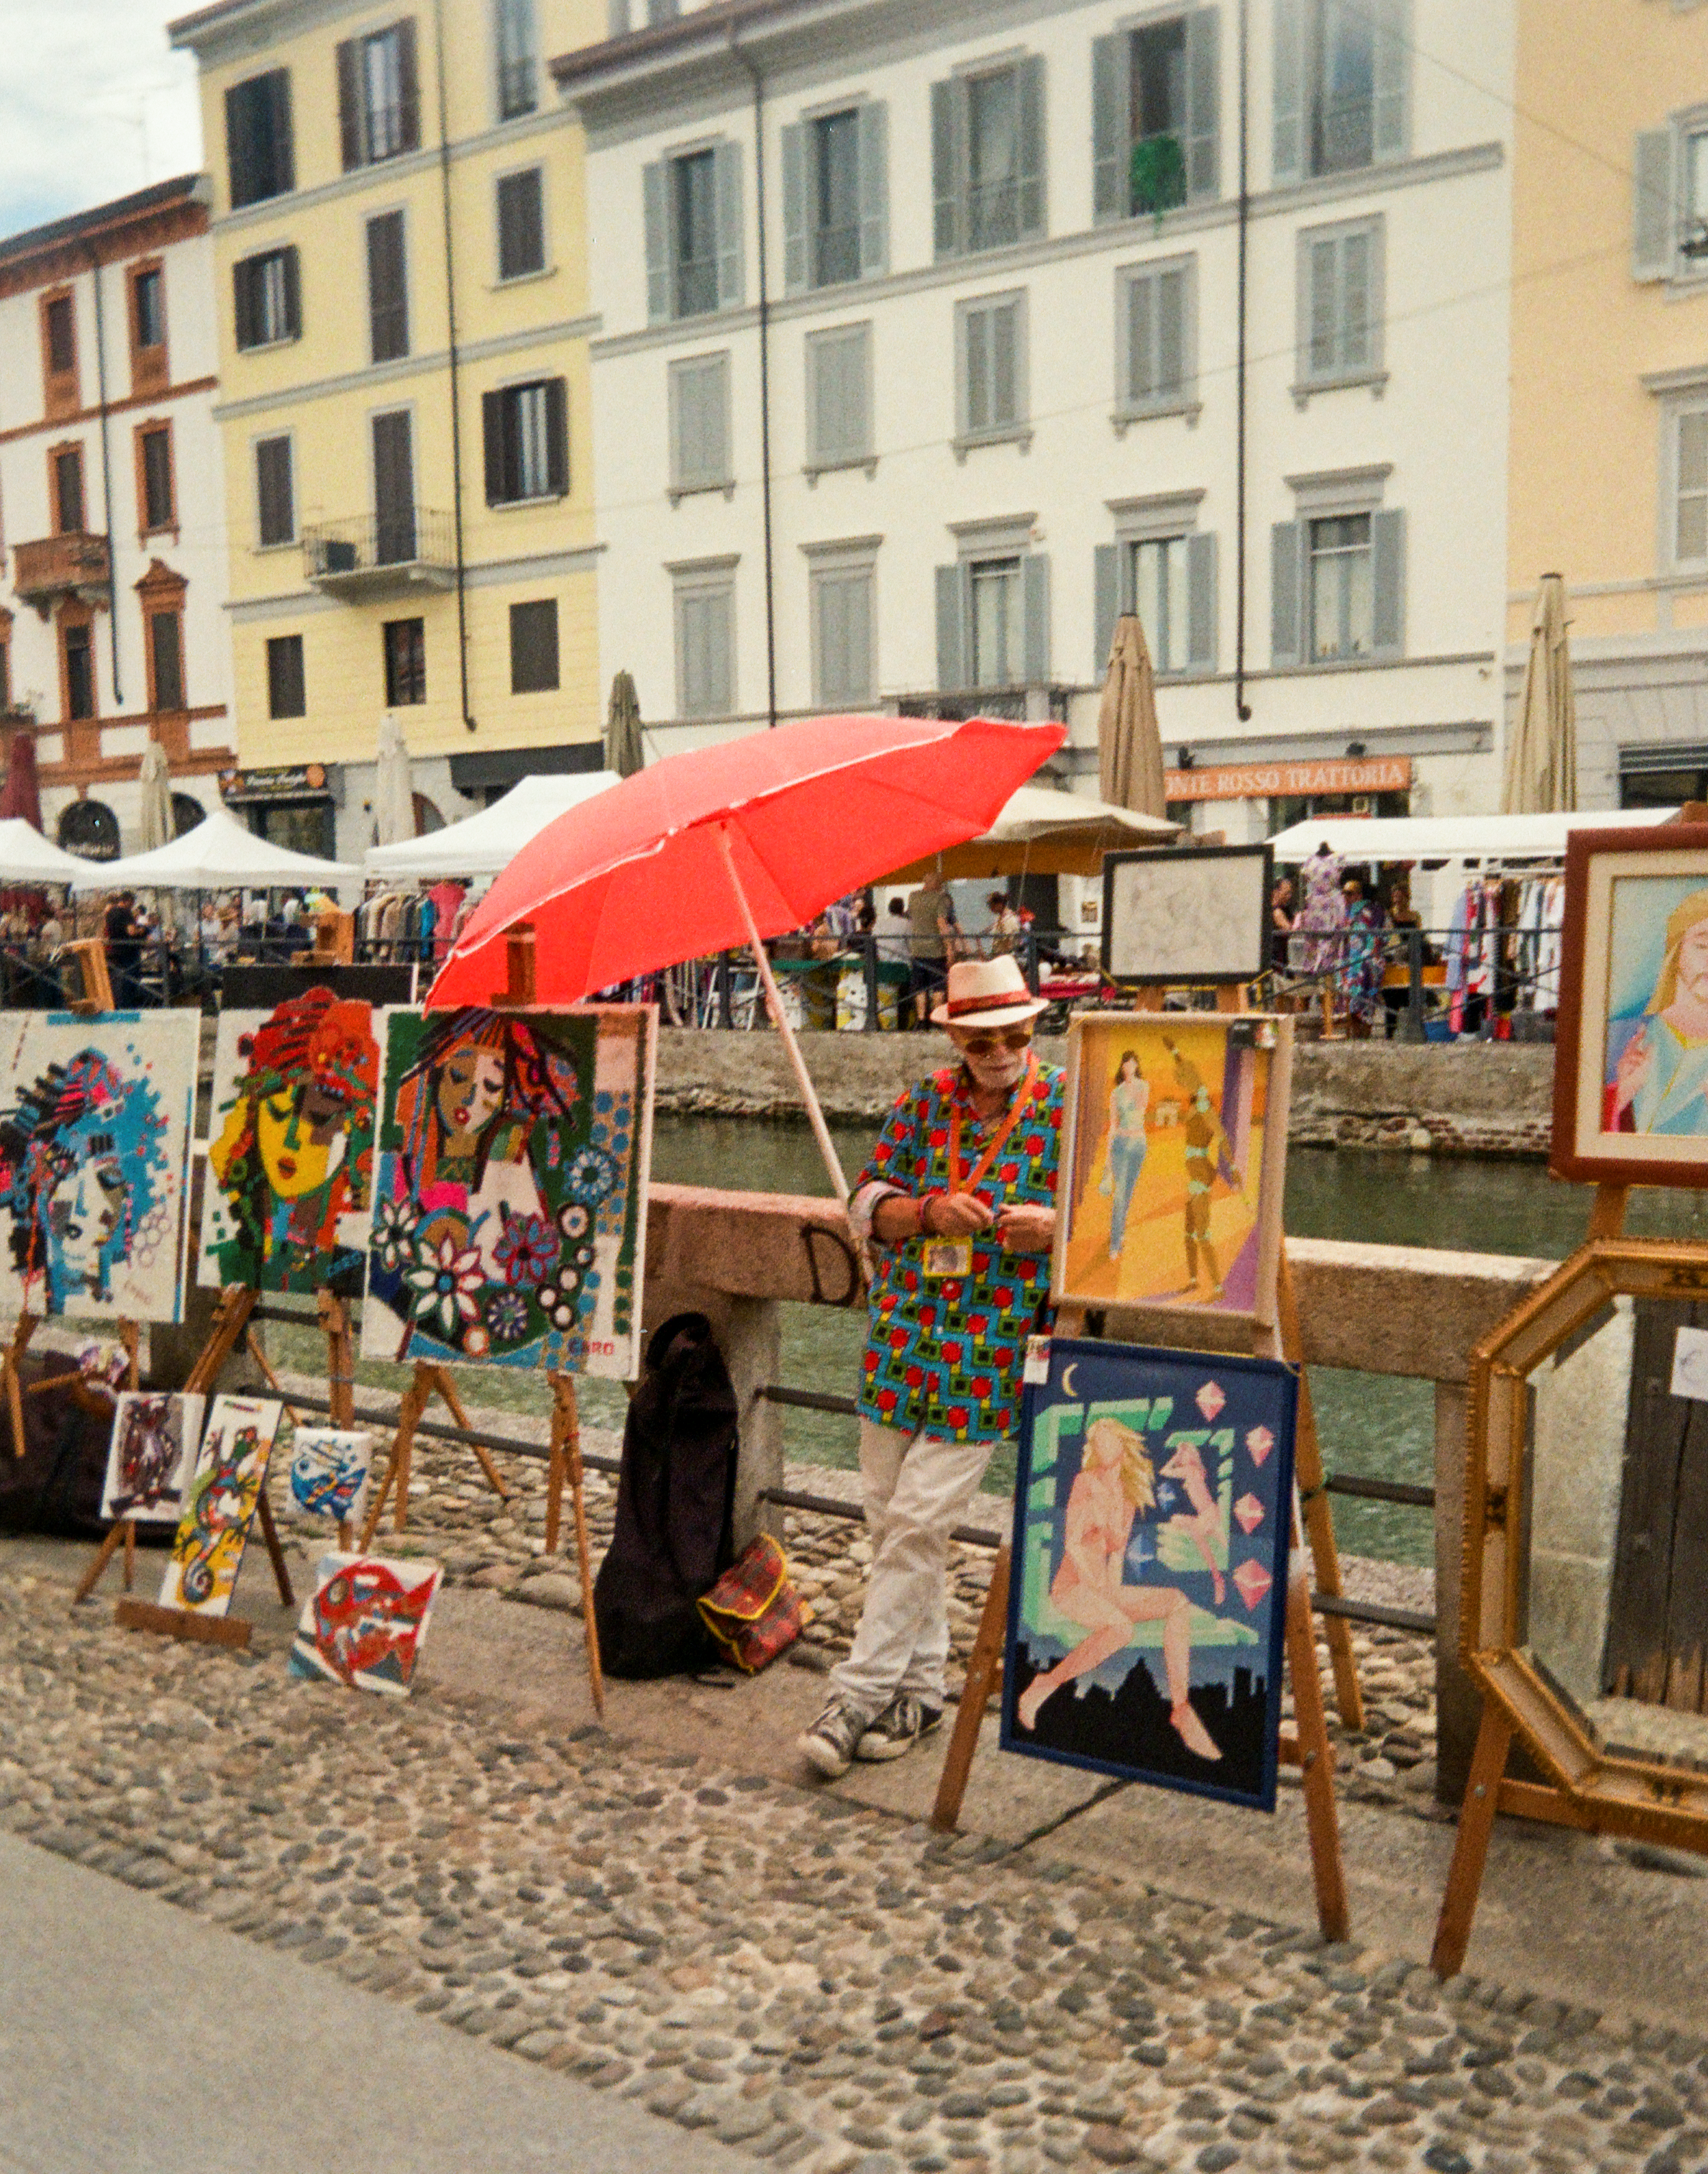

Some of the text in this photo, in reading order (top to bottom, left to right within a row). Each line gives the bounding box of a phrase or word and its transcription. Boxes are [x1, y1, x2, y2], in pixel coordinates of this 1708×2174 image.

[1165, 762, 1405, 795] ONTE ROSSO TRATTORIA
